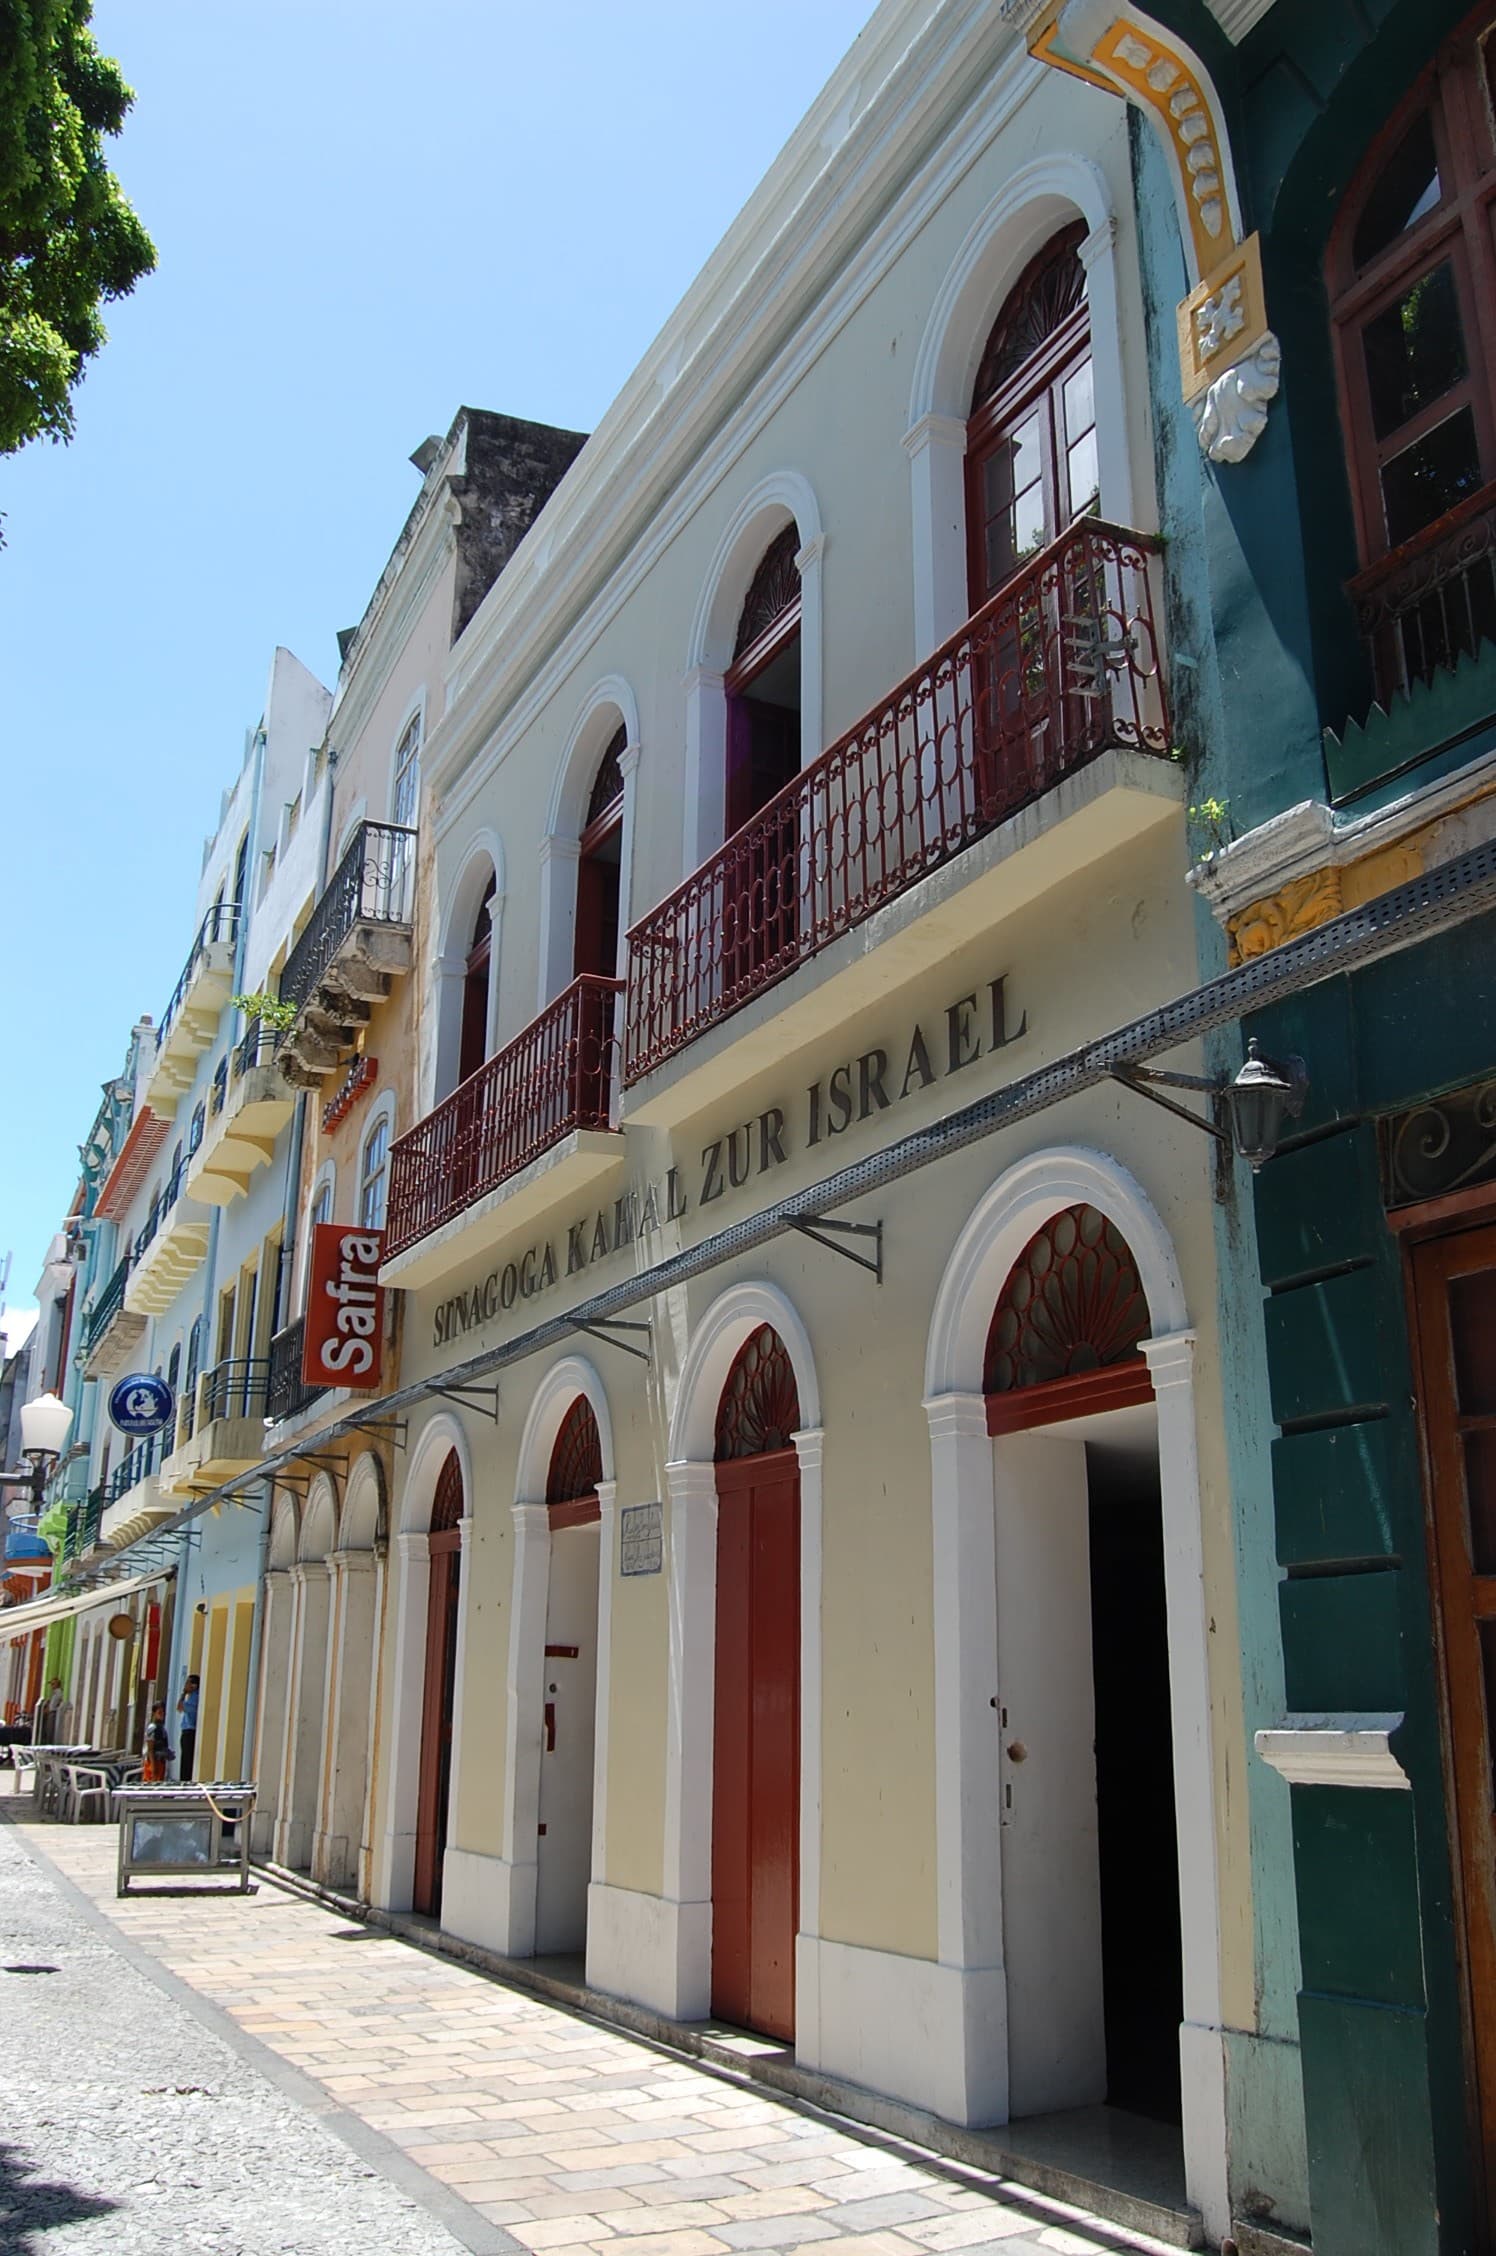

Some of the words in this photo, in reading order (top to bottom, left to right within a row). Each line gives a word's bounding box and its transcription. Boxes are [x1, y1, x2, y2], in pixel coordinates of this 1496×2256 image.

[433, 1241, 556, 1348] SINAGOGA
[565, 1165, 688, 1278] KAHAL
[699, 1107, 788, 1206] ZUR
[806, 973, 1027, 1149] ISRAEL
[321, 1233, 381, 1374] Safra
